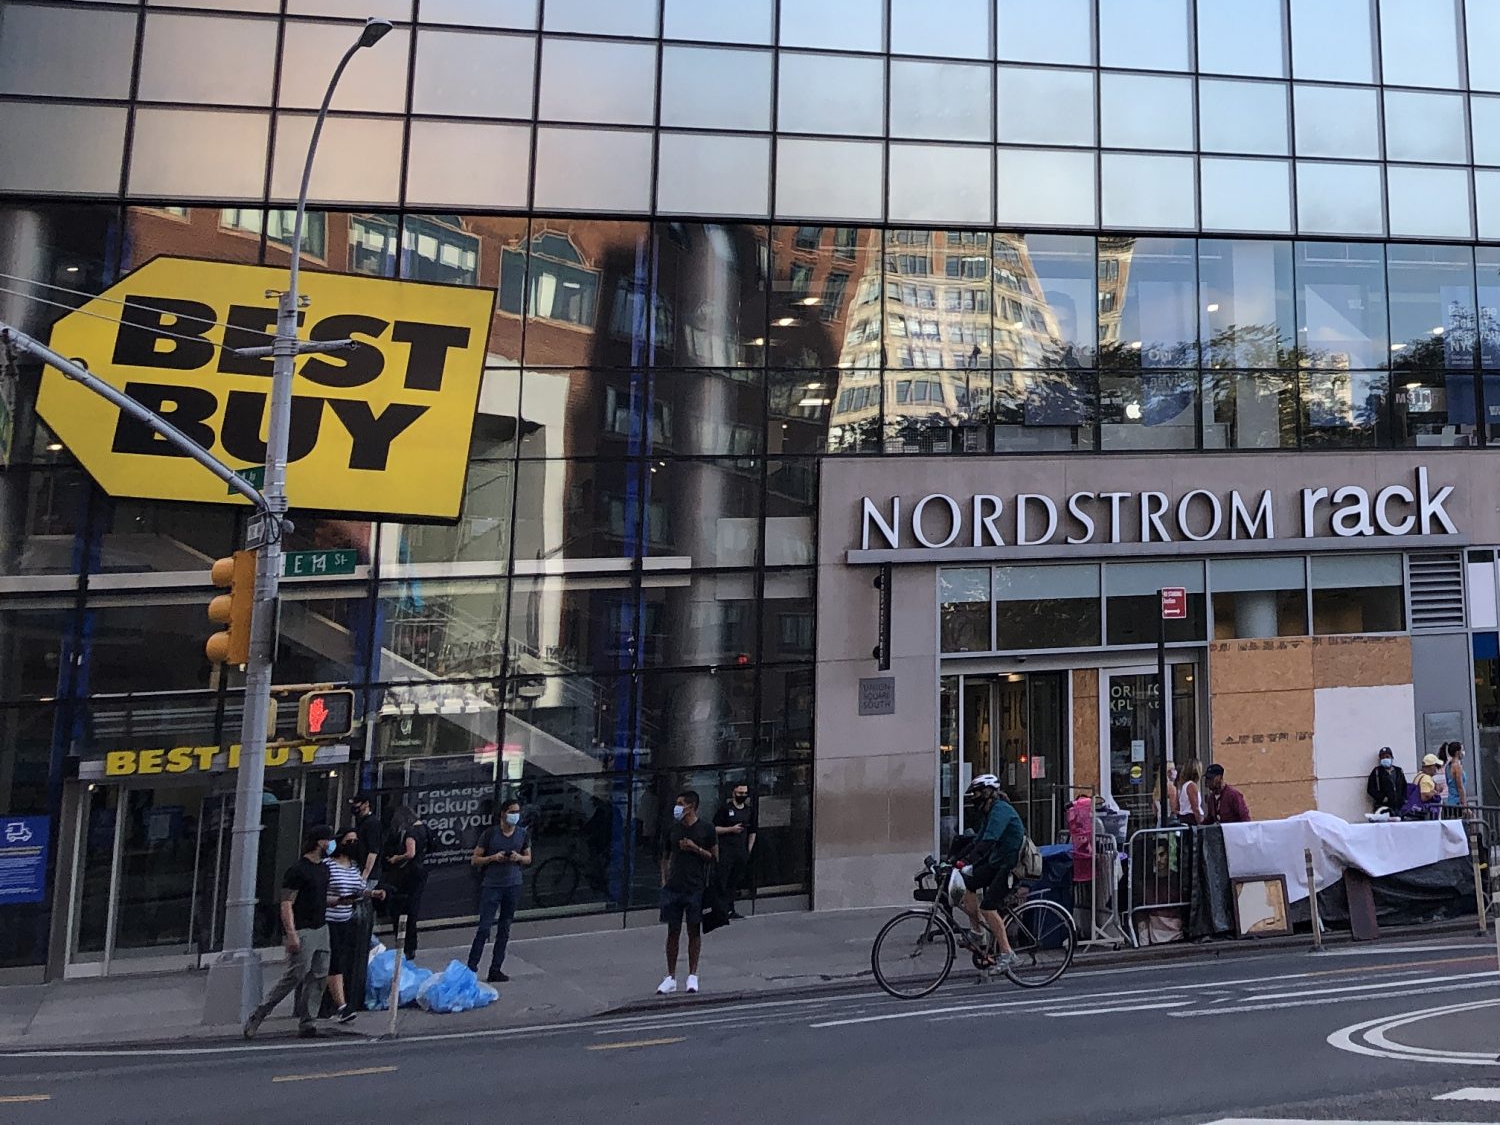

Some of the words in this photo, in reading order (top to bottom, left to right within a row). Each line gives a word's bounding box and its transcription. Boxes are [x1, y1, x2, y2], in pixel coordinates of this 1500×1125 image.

[112, 295, 471, 391] BEST
[112, 381, 430, 471] BUY
[862, 488, 1274, 551] NORDSTROM
[1303, 466, 1459, 537] rack
[294, 556, 303, 573] E
[311, 554, 327, 572] 14
[334, 554, 348, 566] St
[106, 745, 220, 775] BEST
[417, 798, 479, 819] pickup
